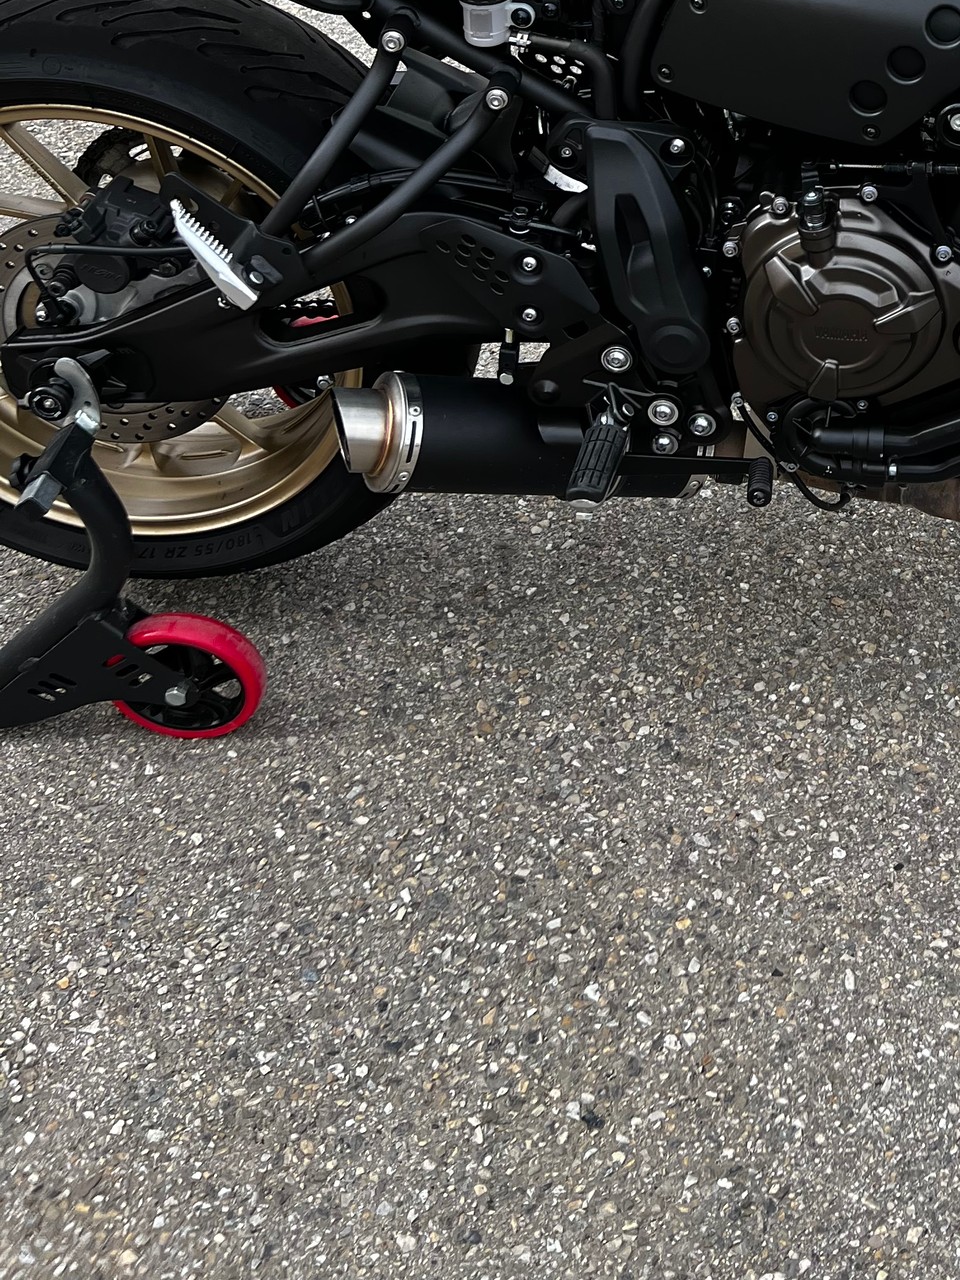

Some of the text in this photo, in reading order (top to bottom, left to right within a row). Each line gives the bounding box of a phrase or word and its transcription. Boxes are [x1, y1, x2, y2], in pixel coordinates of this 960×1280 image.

[139, 533, 252, 559] 180/55 ZR 17
